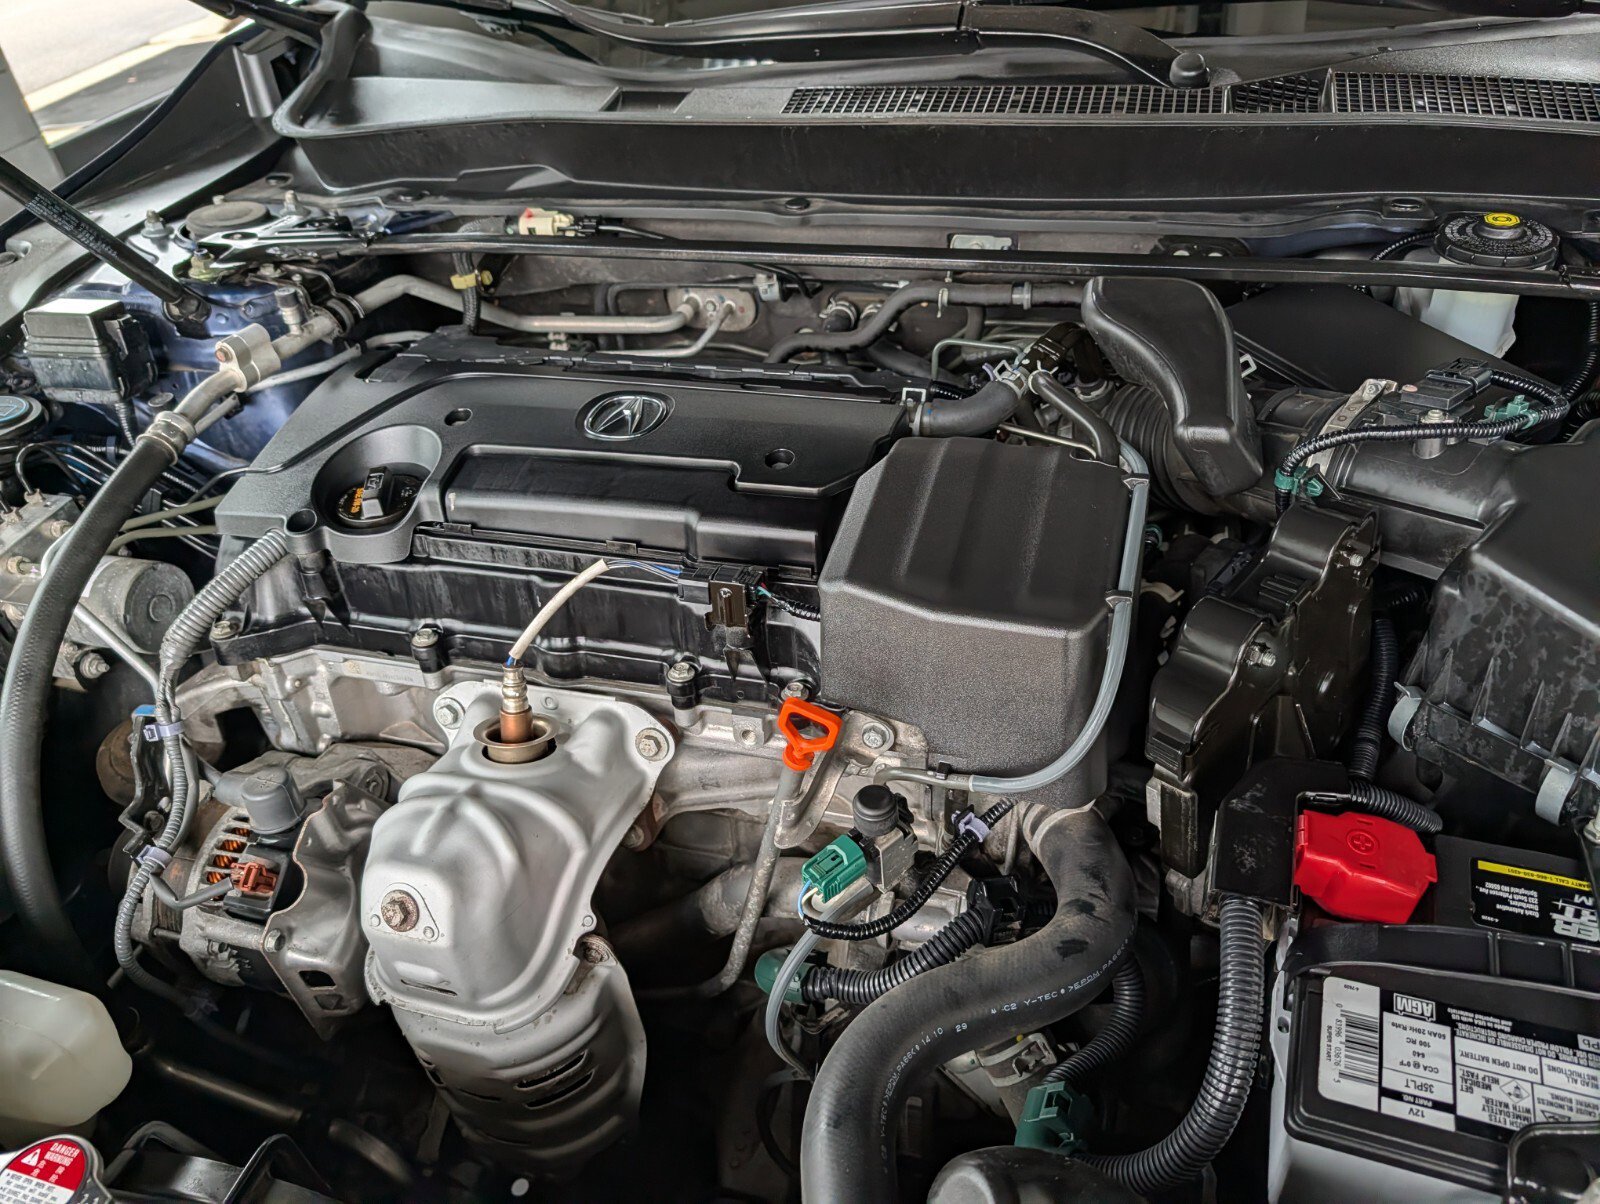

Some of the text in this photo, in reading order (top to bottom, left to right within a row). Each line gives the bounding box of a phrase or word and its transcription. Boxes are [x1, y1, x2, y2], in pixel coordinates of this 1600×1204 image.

[1511, 887, 1537, 897] Springfield
[1513, 894, 1527, 902] South
[1496, 904, 1524, 914] Automotive
[1397, 996, 1432, 1016] AGM
[955, 1022, 968, 1033] 29
[1024, 991, 1058, 1007] Y-TEC
[1391, 1022, 1407, 1030] Rate
[1406, 1037, 1431, 1048] 100 RC
[1583, 1039, 1600, 1050] Pb
[1412, 1050, 1425, 1058] 640
[1492, 1058, 1510, 1068] OPEN
[1513, 1063, 1526, 1072] NOT
[1423, 1065, 1439, 1074] CCA
[1529, 1066, 1538, 1075] DO
[1545, 1064, 1598, 1082] INSTRUCTIONS.
[1460, 1068, 1499, 1085] HELP FAST.
[1404, 1078, 1434, 1093] 35PLT
[1460, 1076, 1492, 1091] MEDICAL
[1566, 1078, 1578, 1086] ALL
[1460, 1085, 1473, 1094] GET
[1415, 1098, 1432, 1106] PART
[1408, 1108, 1425, 1118] 12V
[1512, 1104, 1531, 1115] WITH
[1537, 1098, 1596, 1118] CAUSE BLINDNESS
[1482, 1105, 1532, 1123] IMMEDIATELY
[1488, 1114, 1506, 1125] EYES
[50, 1143, 80, 1158] DANGER
